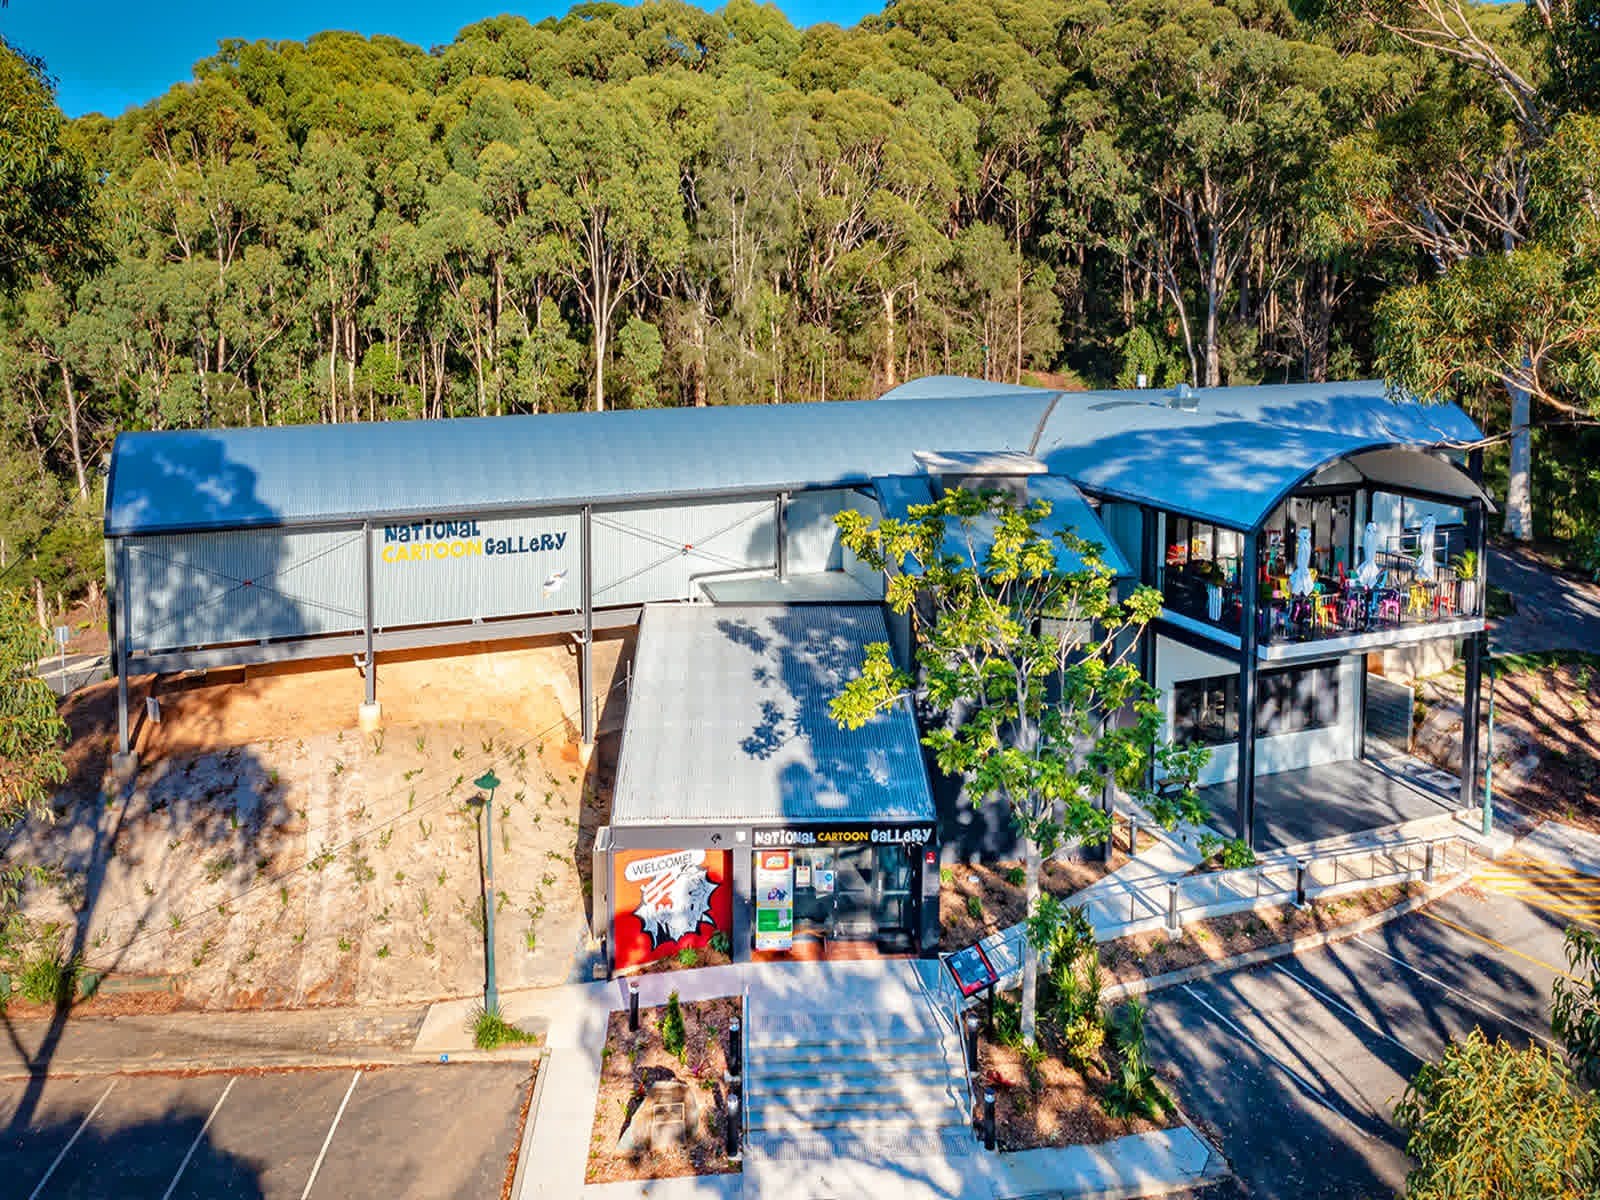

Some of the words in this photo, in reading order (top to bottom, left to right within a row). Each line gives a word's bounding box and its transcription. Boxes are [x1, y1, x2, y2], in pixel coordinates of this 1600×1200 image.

[382, 540, 481, 563] CARTOON
[817, 832, 868, 841] CARTOON
[632, 852, 692, 875] WELCOME!
